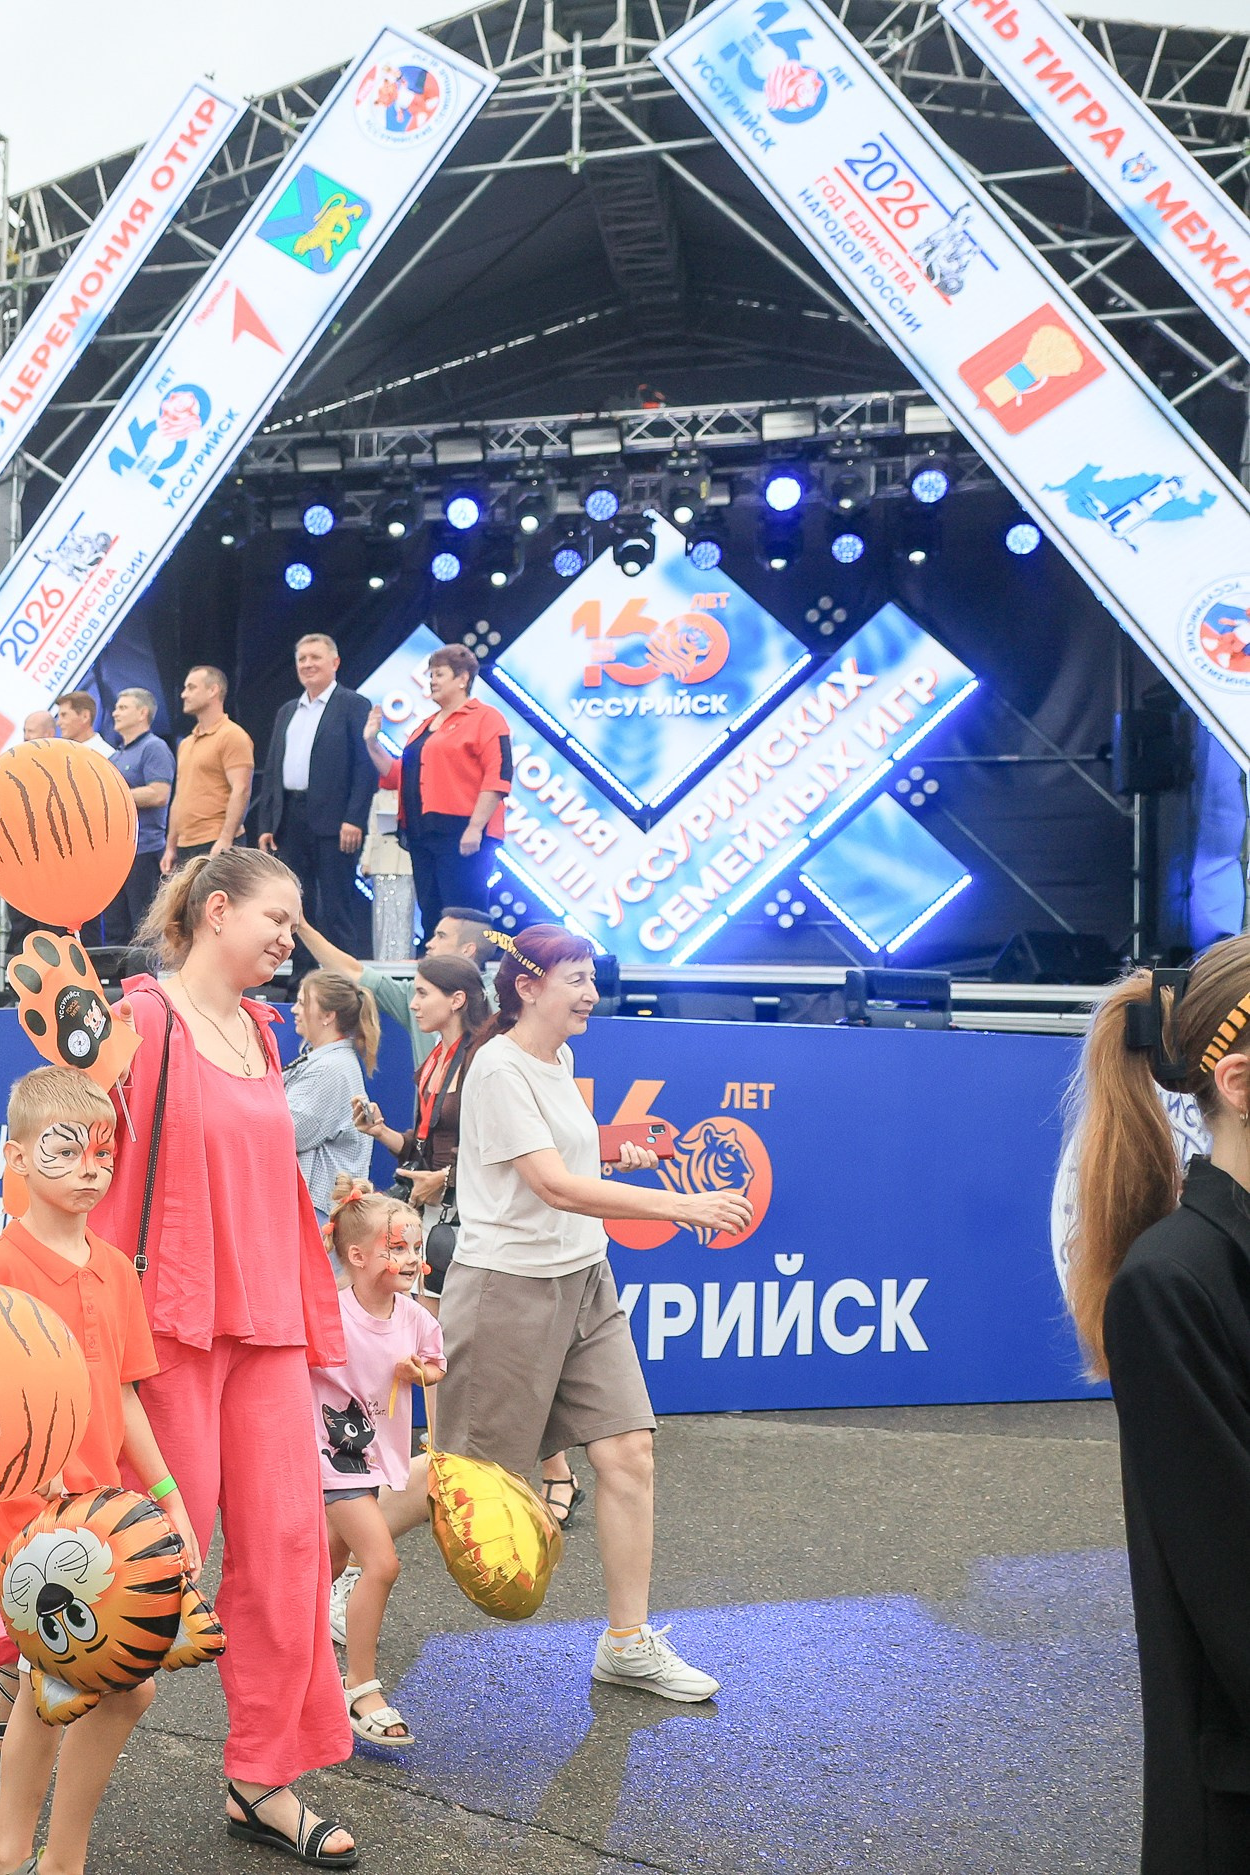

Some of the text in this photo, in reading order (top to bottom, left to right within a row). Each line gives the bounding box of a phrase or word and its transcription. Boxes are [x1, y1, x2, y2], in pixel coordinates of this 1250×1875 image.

[692, 54, 776, 152] УССУРИЙСК
[828, 66, 854, 91] ЛЕТ
[844, 142, 930, 230] 2026
[1022, 36, 1126, 159] ТИГРА
[1144, 180, 1250, 316] МЕЖД
[0, 198, 154, 415] ЦЕРЕМОНИЯ
[150, 96, 217, 192] ОТКР
[798, 188, 923, 333] НАРОДОВ РОССИИ
[814, 175, 918, 295] ГОД ЕДИНСТВА
[155, 366, 176, 393] ЛЕТ
[163, 408, 240, 509] УССУРИЙСК
[0, 584, 65, 666] 2026
[32, 568, 117, 682] ГОД ЕДИНСТВА
[45, 550, 148, 692] НАРОДОВ РОССИИ
[691, 592, 731, 609] ЛЕТ
[569, 689, 729, 718] УССУРИЙСК
[589, 657, 877, 929] УССУРИЙСКИХ
[638, 666, 938, 952] СЕМЕЙНЫХ ИГР
[720, 1082, 775, 1110] ЛЕТ
